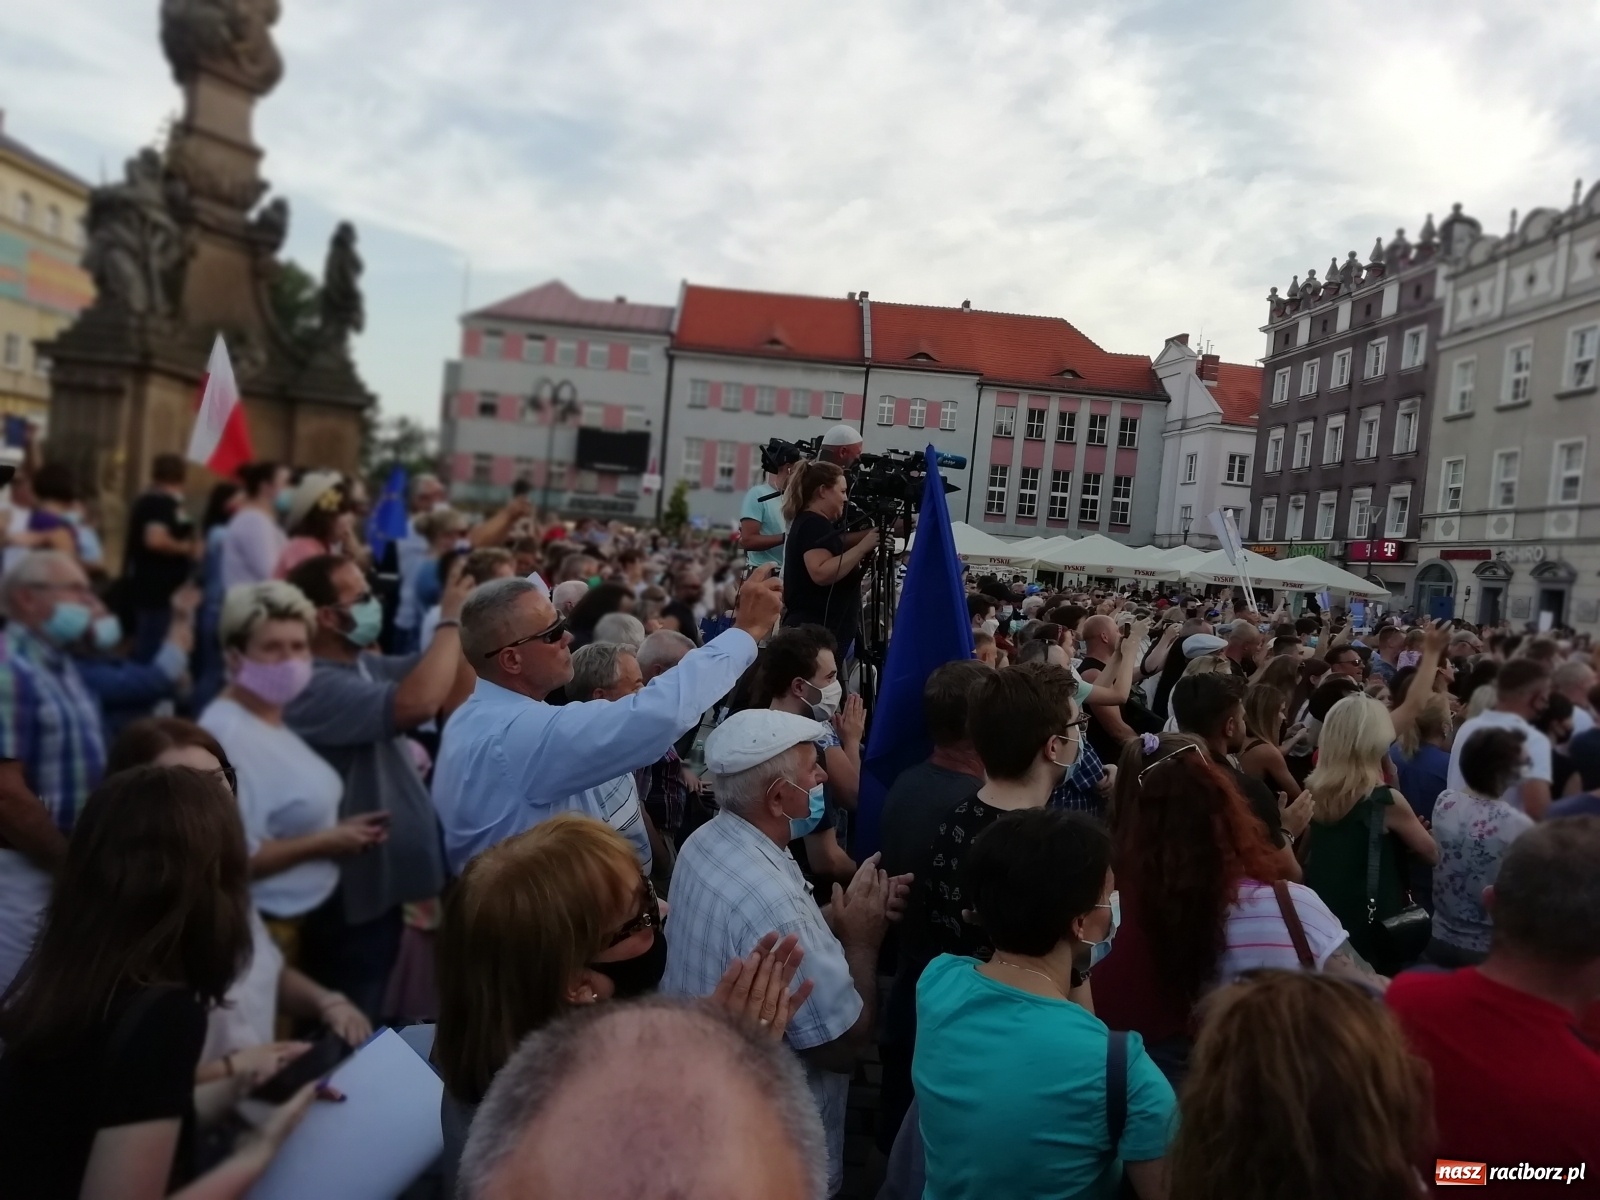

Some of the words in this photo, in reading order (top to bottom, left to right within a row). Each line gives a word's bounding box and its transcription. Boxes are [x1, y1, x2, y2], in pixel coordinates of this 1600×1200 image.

[1288, 544, 1326, 559] KANTOR
[1064, 564, 1087, 572] TYSKIE
[1134, 569, 1157, 577] TYSKIE
[1213, 575, 1235, 583] TYSKIE
[1282, 581, 1305, 589] TYSKIE
